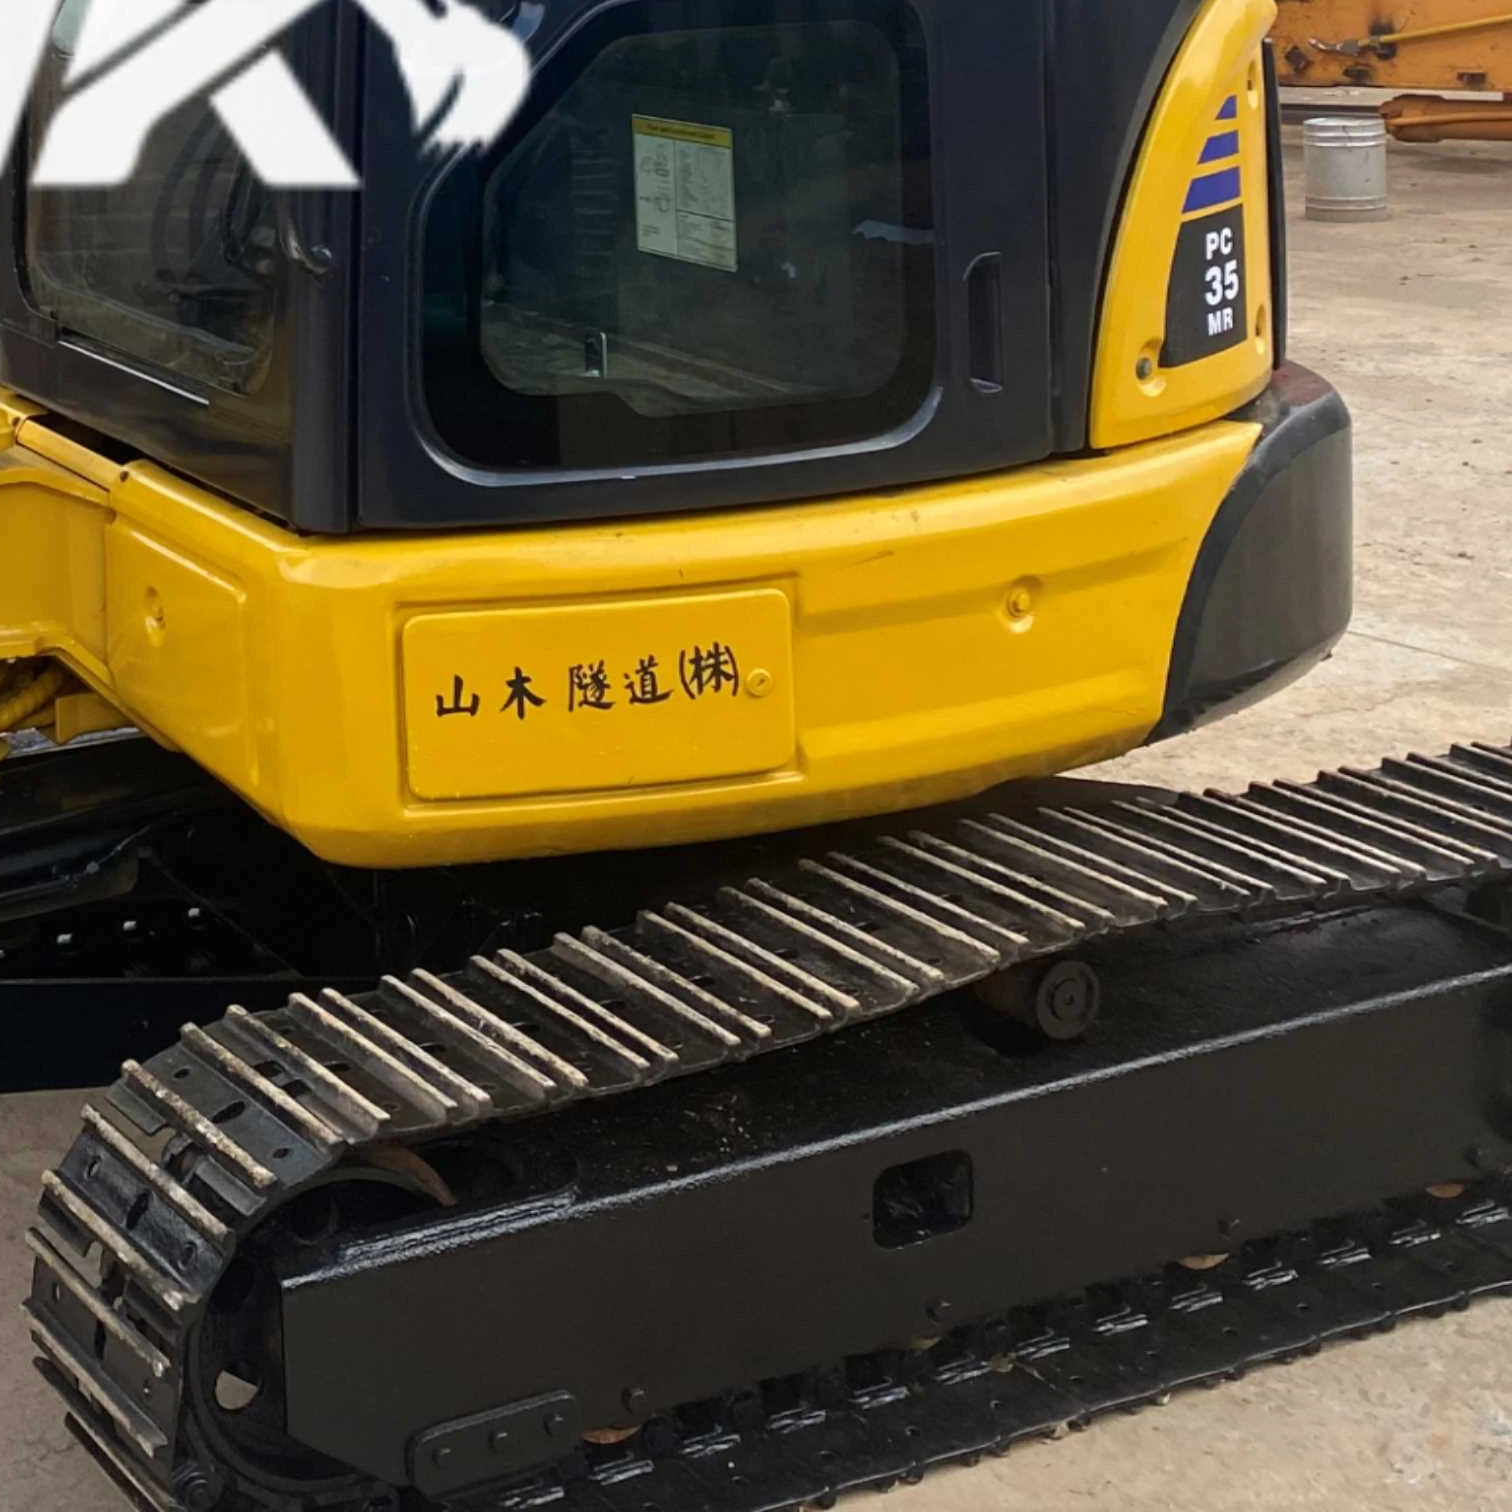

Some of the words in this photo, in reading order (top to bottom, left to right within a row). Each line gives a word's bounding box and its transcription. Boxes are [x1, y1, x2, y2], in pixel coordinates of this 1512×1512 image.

[1205, 227, 1233, 261] PC
[1204, 259, 1240, 307] 35
[1207, 306, 1234, 337] MR
